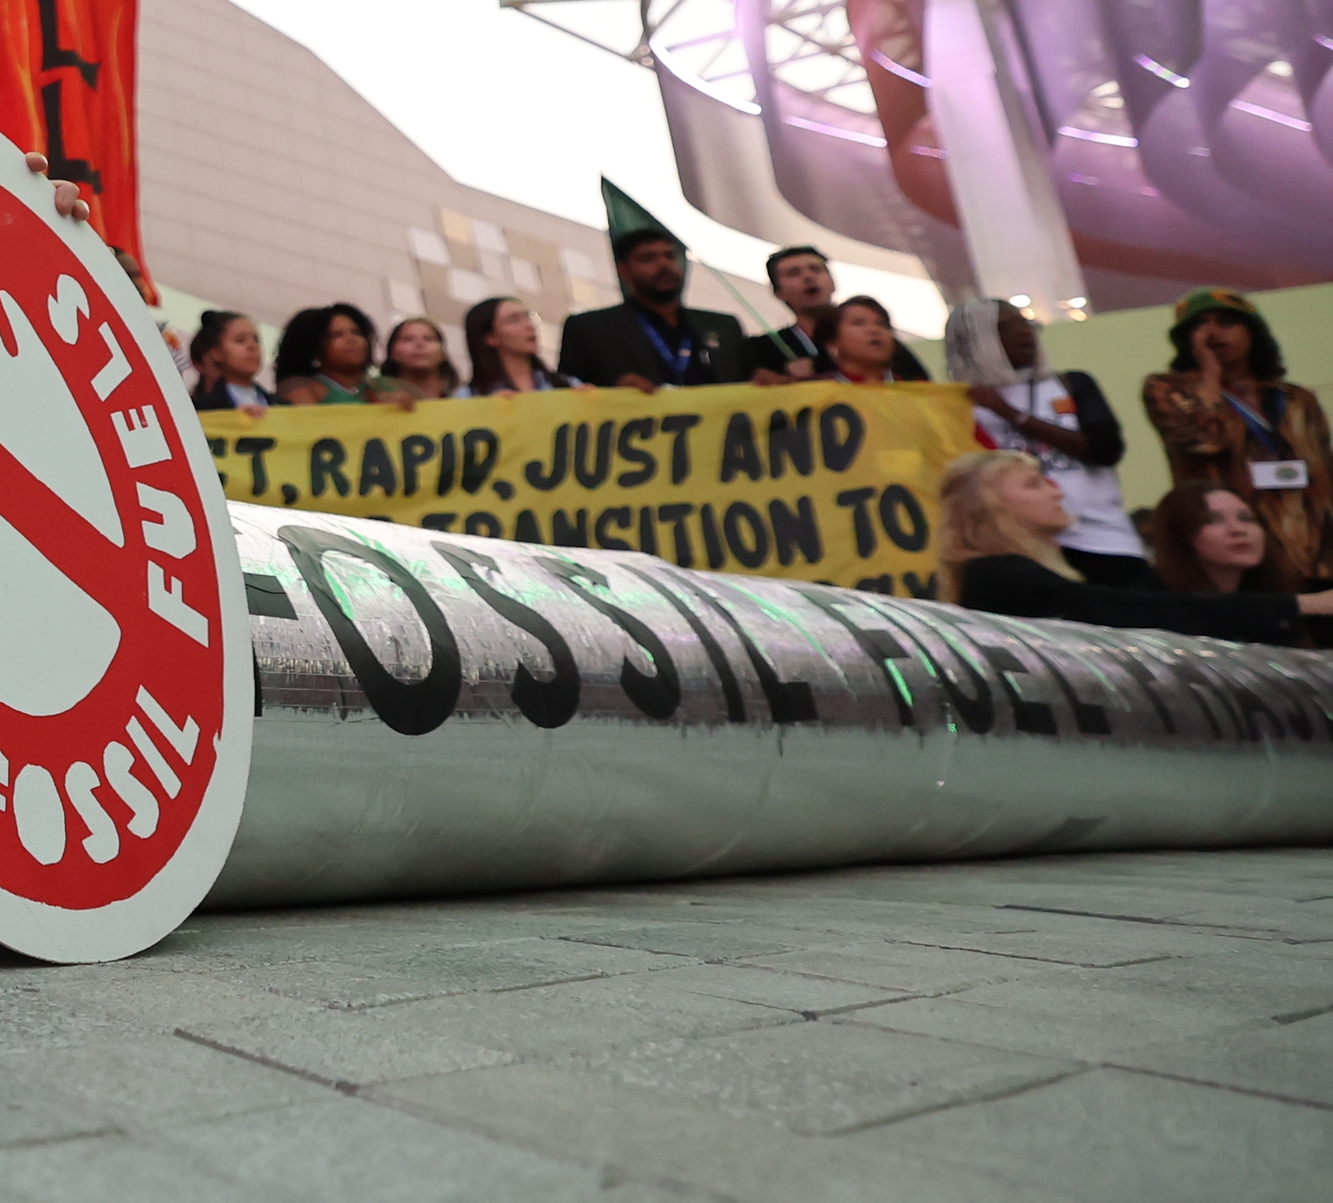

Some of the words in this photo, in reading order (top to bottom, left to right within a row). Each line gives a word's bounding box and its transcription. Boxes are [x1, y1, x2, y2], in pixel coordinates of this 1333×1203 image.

[45, 272, 212, 649] FUELS
[310, 427, 515, 501] RAPID,
[525, 412, 702, 492] JUST
[720, 402, 866, 483] AND
[836, 483, 930, 560] TO
[242, 524, 819, 736] OSSIL
